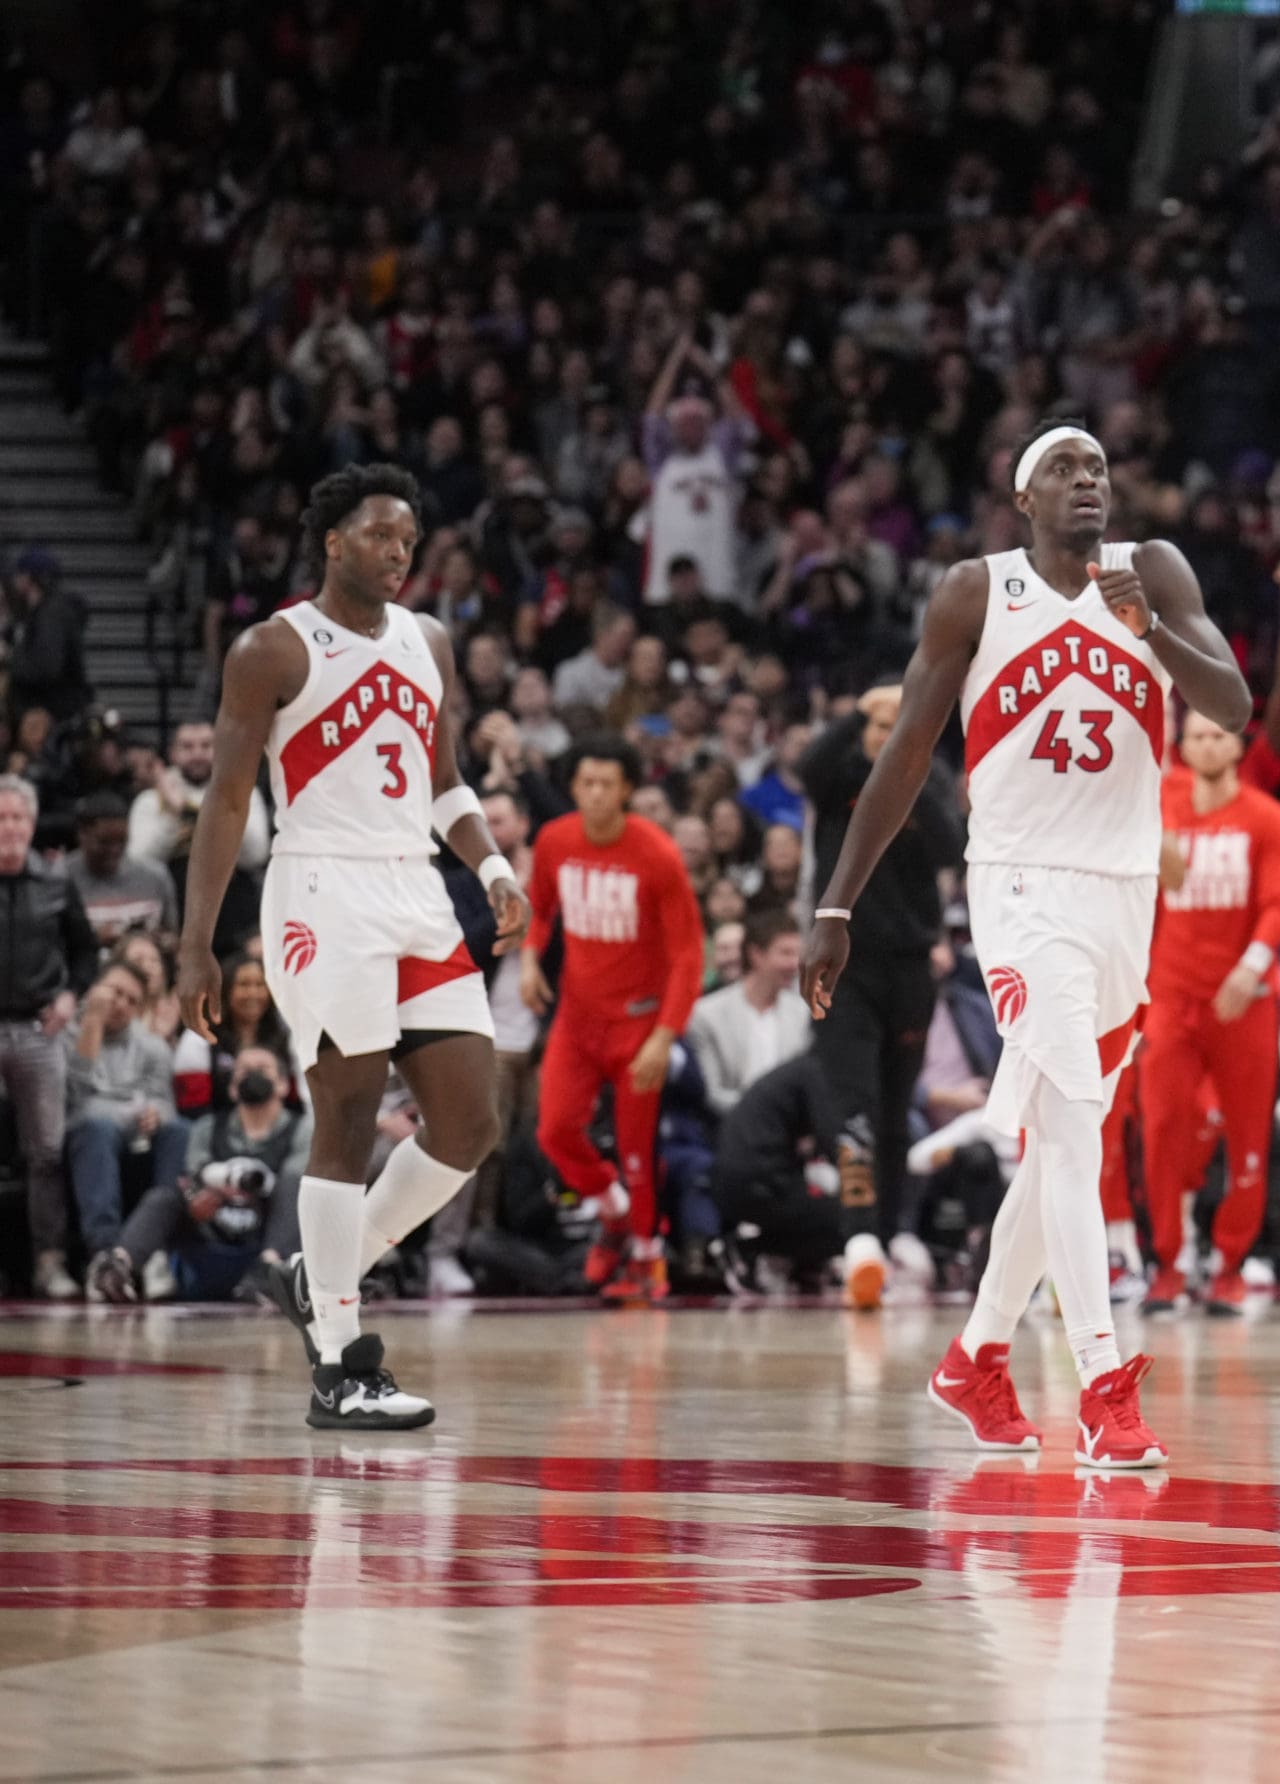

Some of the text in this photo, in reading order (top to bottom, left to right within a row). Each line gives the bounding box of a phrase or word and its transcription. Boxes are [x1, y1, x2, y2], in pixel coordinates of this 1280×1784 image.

[1008, 580, 1023, 596] 6
[998, 636, 1147, 714] RAPTORS
[376, 742, 407, 798] 3
[1030, 710, 1114, 774] 43
